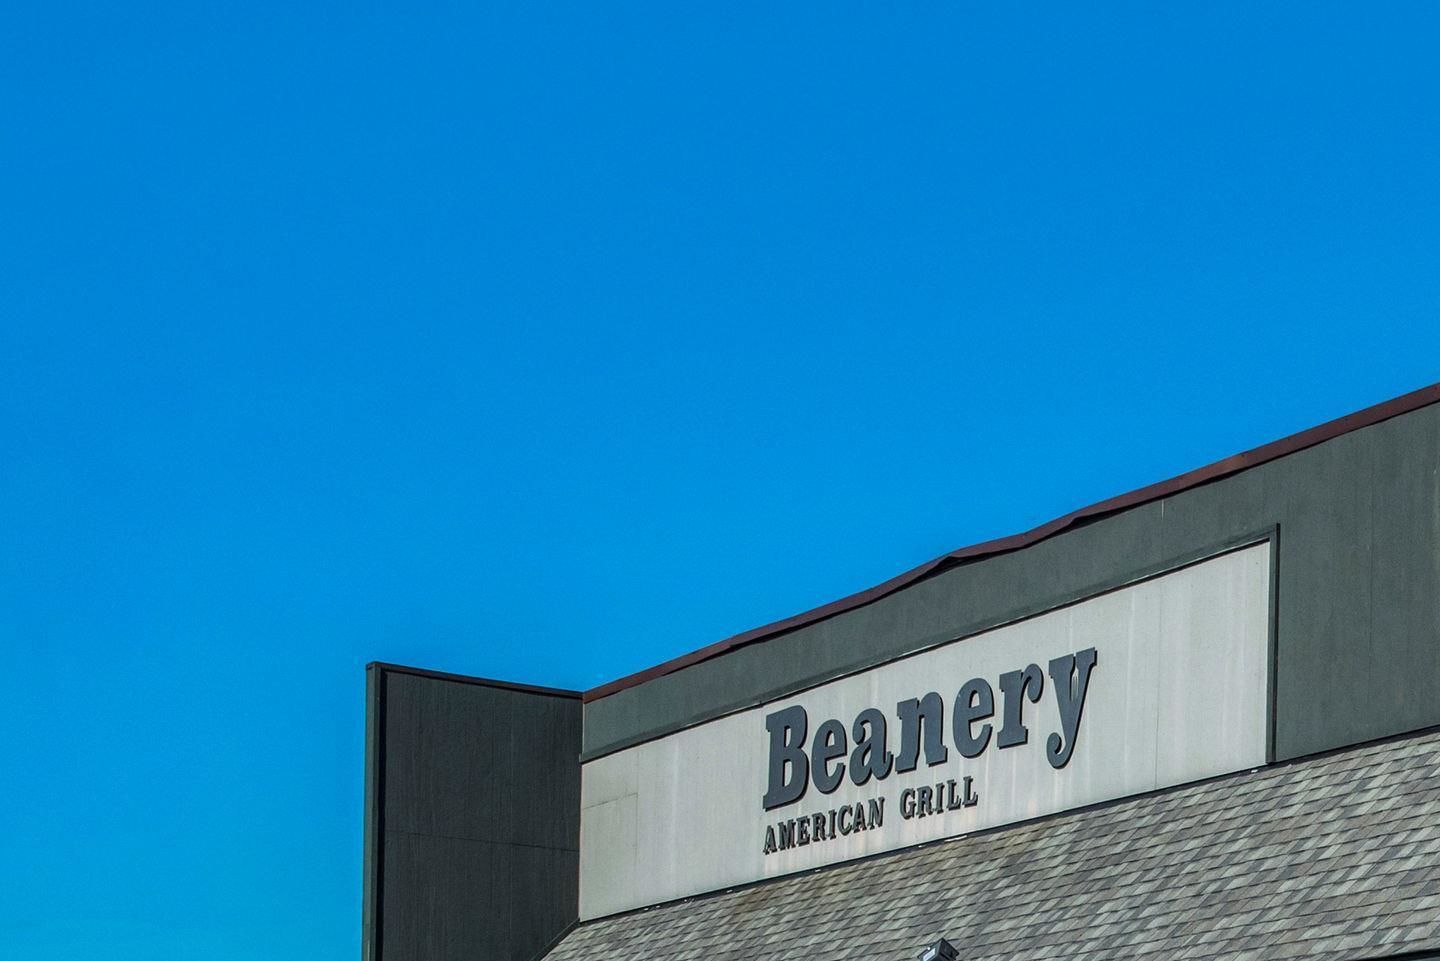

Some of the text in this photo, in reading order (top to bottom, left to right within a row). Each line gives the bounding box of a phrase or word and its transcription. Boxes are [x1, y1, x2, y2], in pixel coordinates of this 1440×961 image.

[763, 647, 1097, 810] Beanery
[763, 775, 978, 855] AMERICAN GRILL
